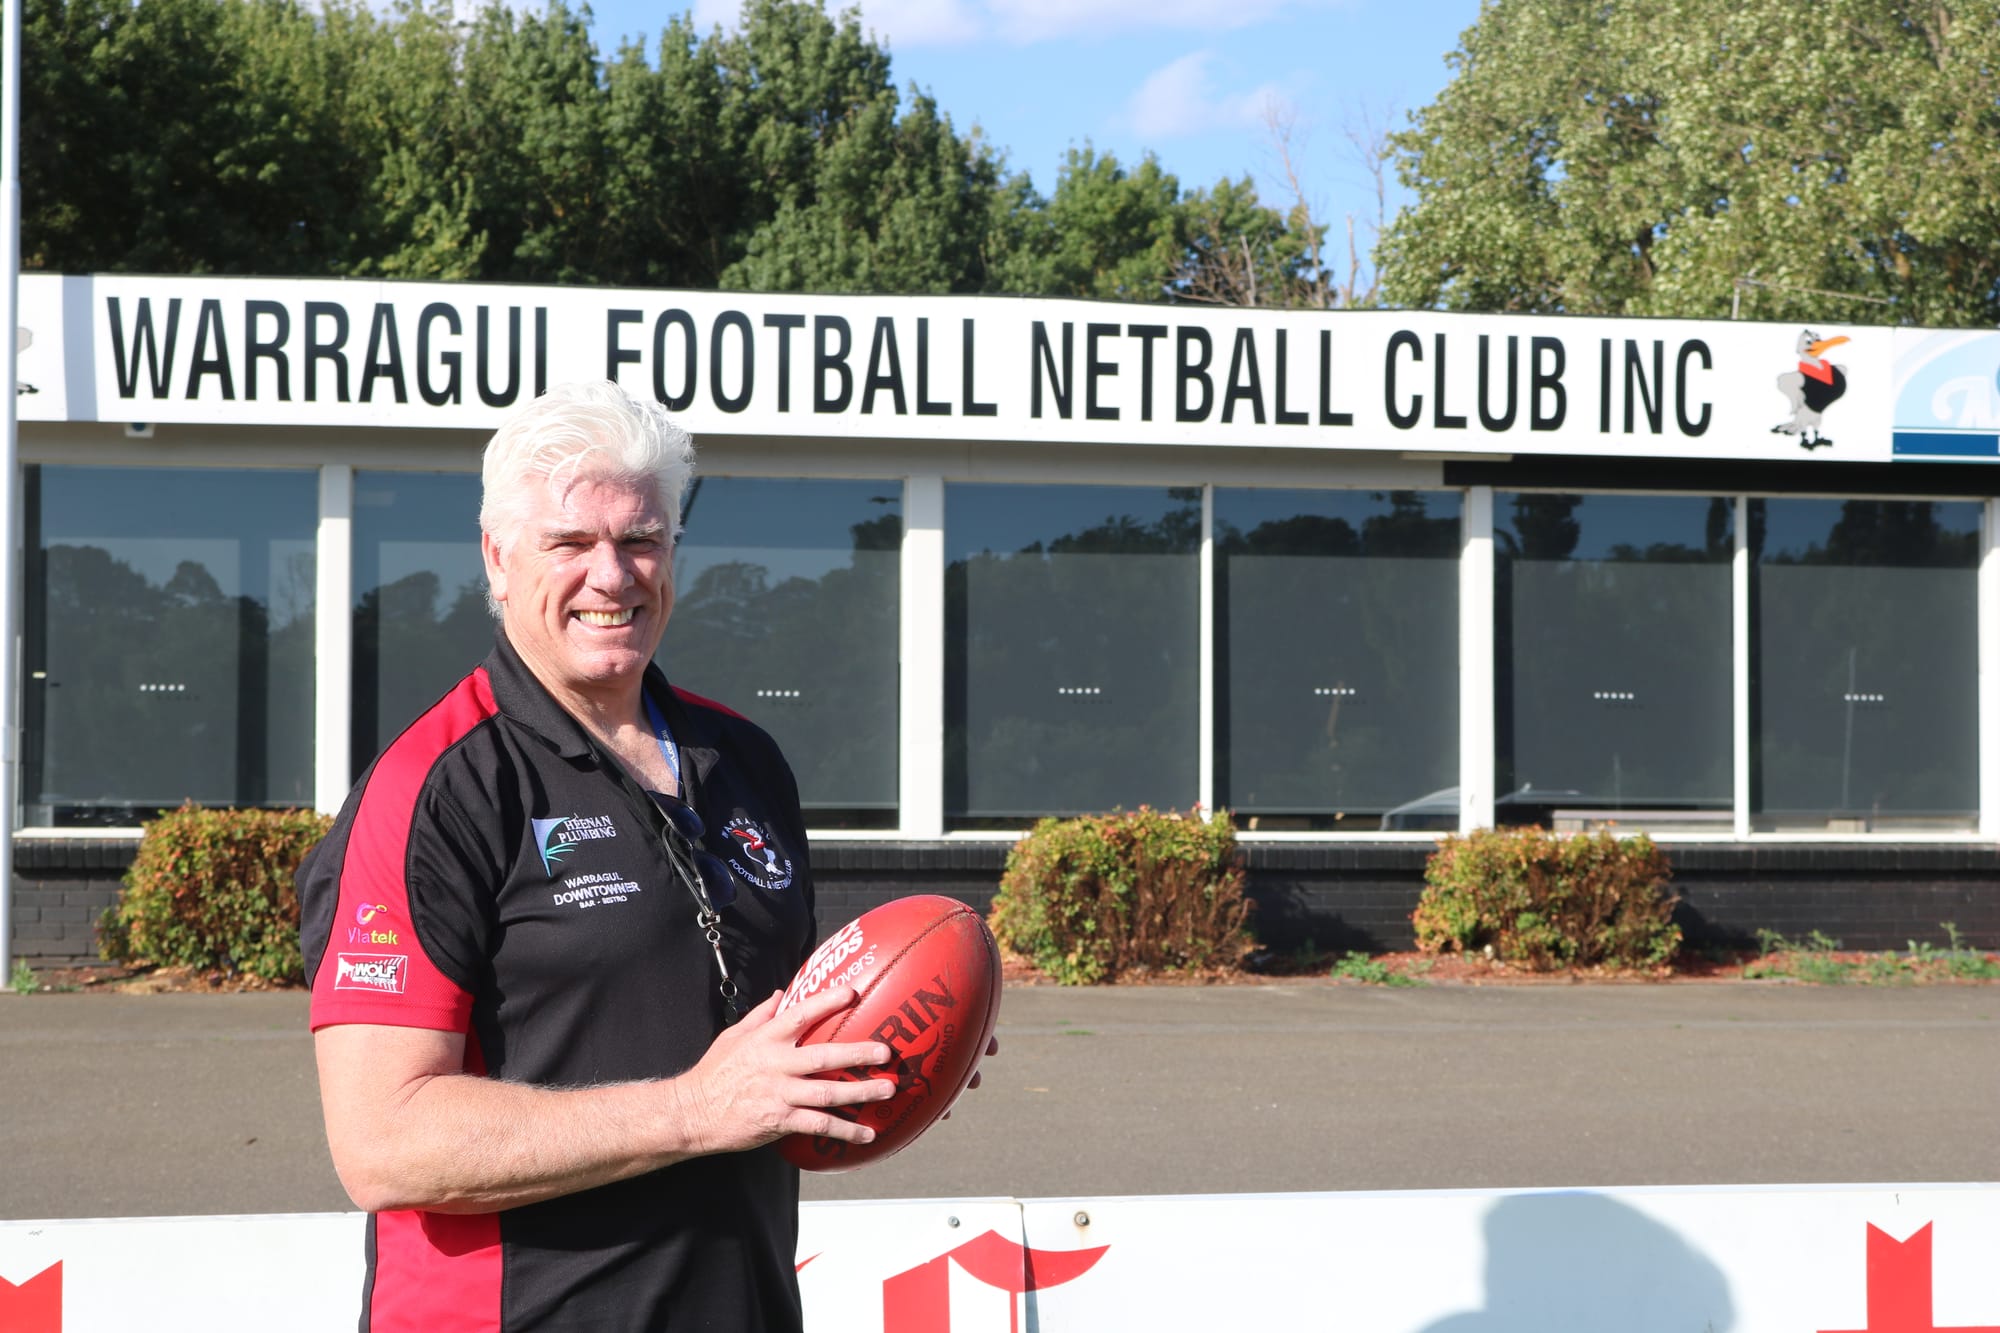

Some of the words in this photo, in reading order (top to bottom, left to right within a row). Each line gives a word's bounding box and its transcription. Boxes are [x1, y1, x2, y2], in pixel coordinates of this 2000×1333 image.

[607, 308, 998, 417] FOOTBALL
[1030, 320, 1354, 427] NETBALL
[1384, 329, 1567, 432] CLUB
[1600, 338, 1713, 437] INC
[563, 815, 613, 831] HEENAN
[556, 826, 617, 844] PLUMBING
[563, 872, 624, 889] WARRAGUL
[728, 858, 766, 888] FOOTBALL
[552, 881, 641, 906] DOWNTOWNER
[578, 899, 596, 909] BAR
[355, 962, 397, 979] WOLF
[932, 1023, 956, 1073] BRAND
